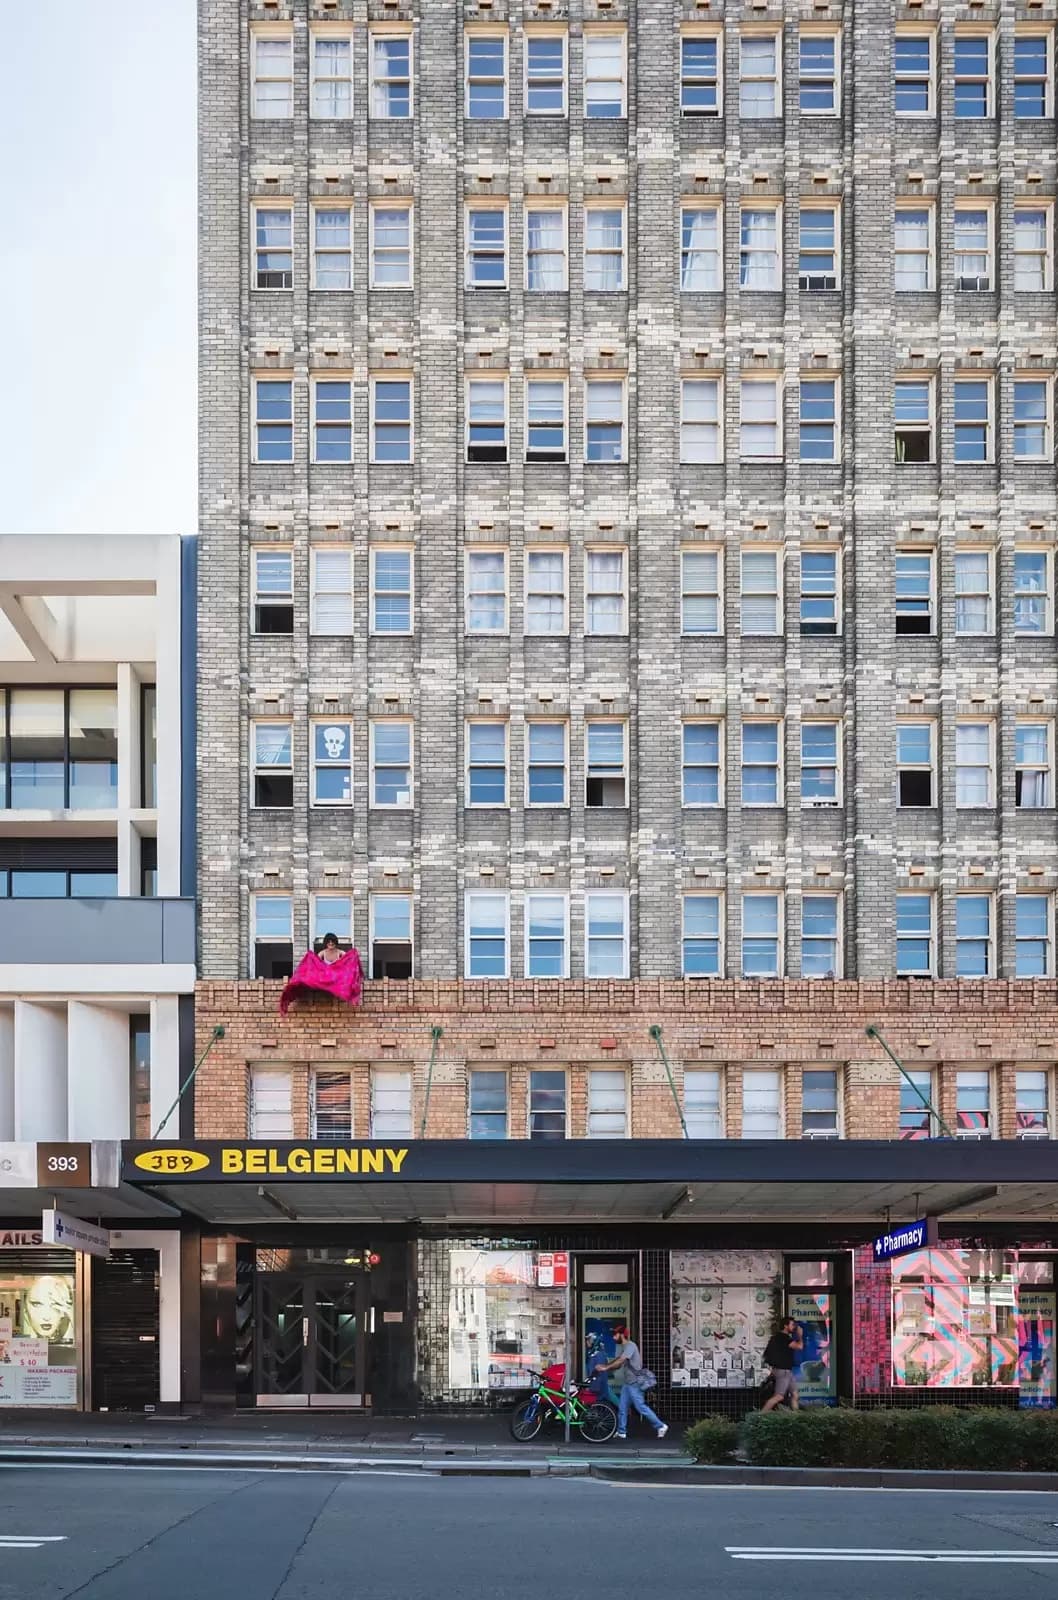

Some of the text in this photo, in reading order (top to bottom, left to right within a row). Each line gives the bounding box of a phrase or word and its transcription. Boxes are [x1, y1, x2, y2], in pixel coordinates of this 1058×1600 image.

[47, 1156, 78, 1171] 393
[151, 1149, 408, 1173] 389 BELGENNY
[883, 1227, 923, 1253] Pharmacy
[590, 1293, 622, 1301] Serafim
[585, 1305, 626, 1314] Pharmacy
